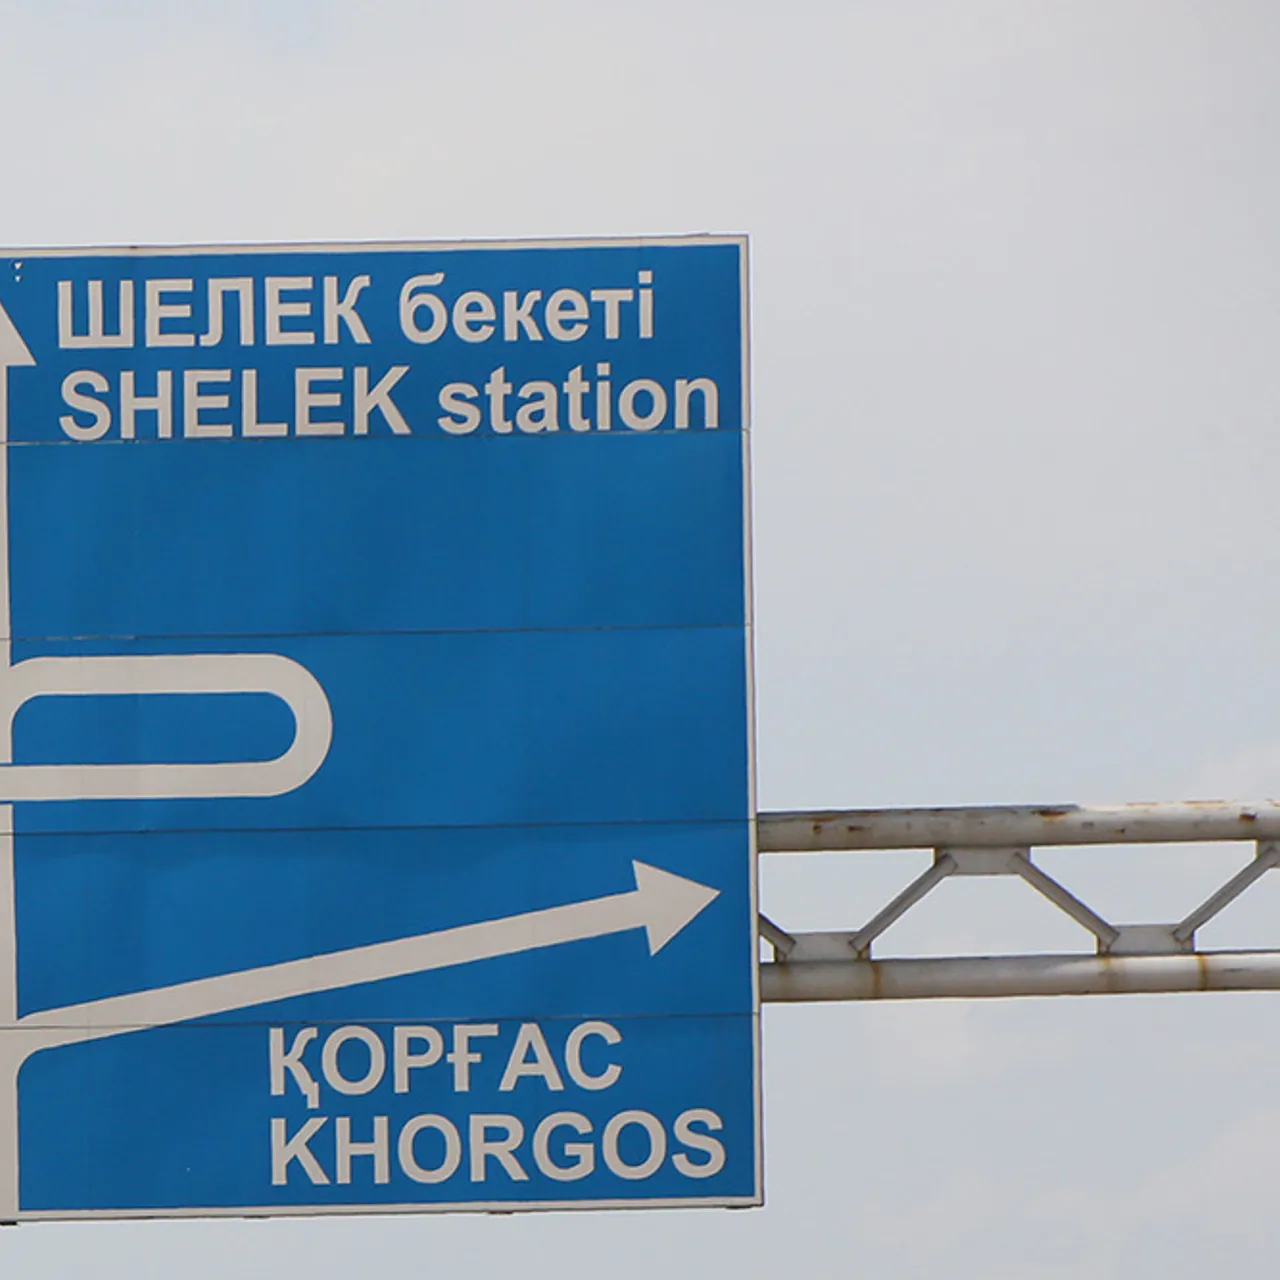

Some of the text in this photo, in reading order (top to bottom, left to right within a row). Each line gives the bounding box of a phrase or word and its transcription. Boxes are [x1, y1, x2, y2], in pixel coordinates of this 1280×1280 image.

[57, 270, 653, 349] ШЕЛЕК бекеті
[59, 362, 719, 441] SHELEK station
[269, 1021, 623, 1109] ҚОРҒАС
[271, 1108, 727, 1186] KHORGOS
